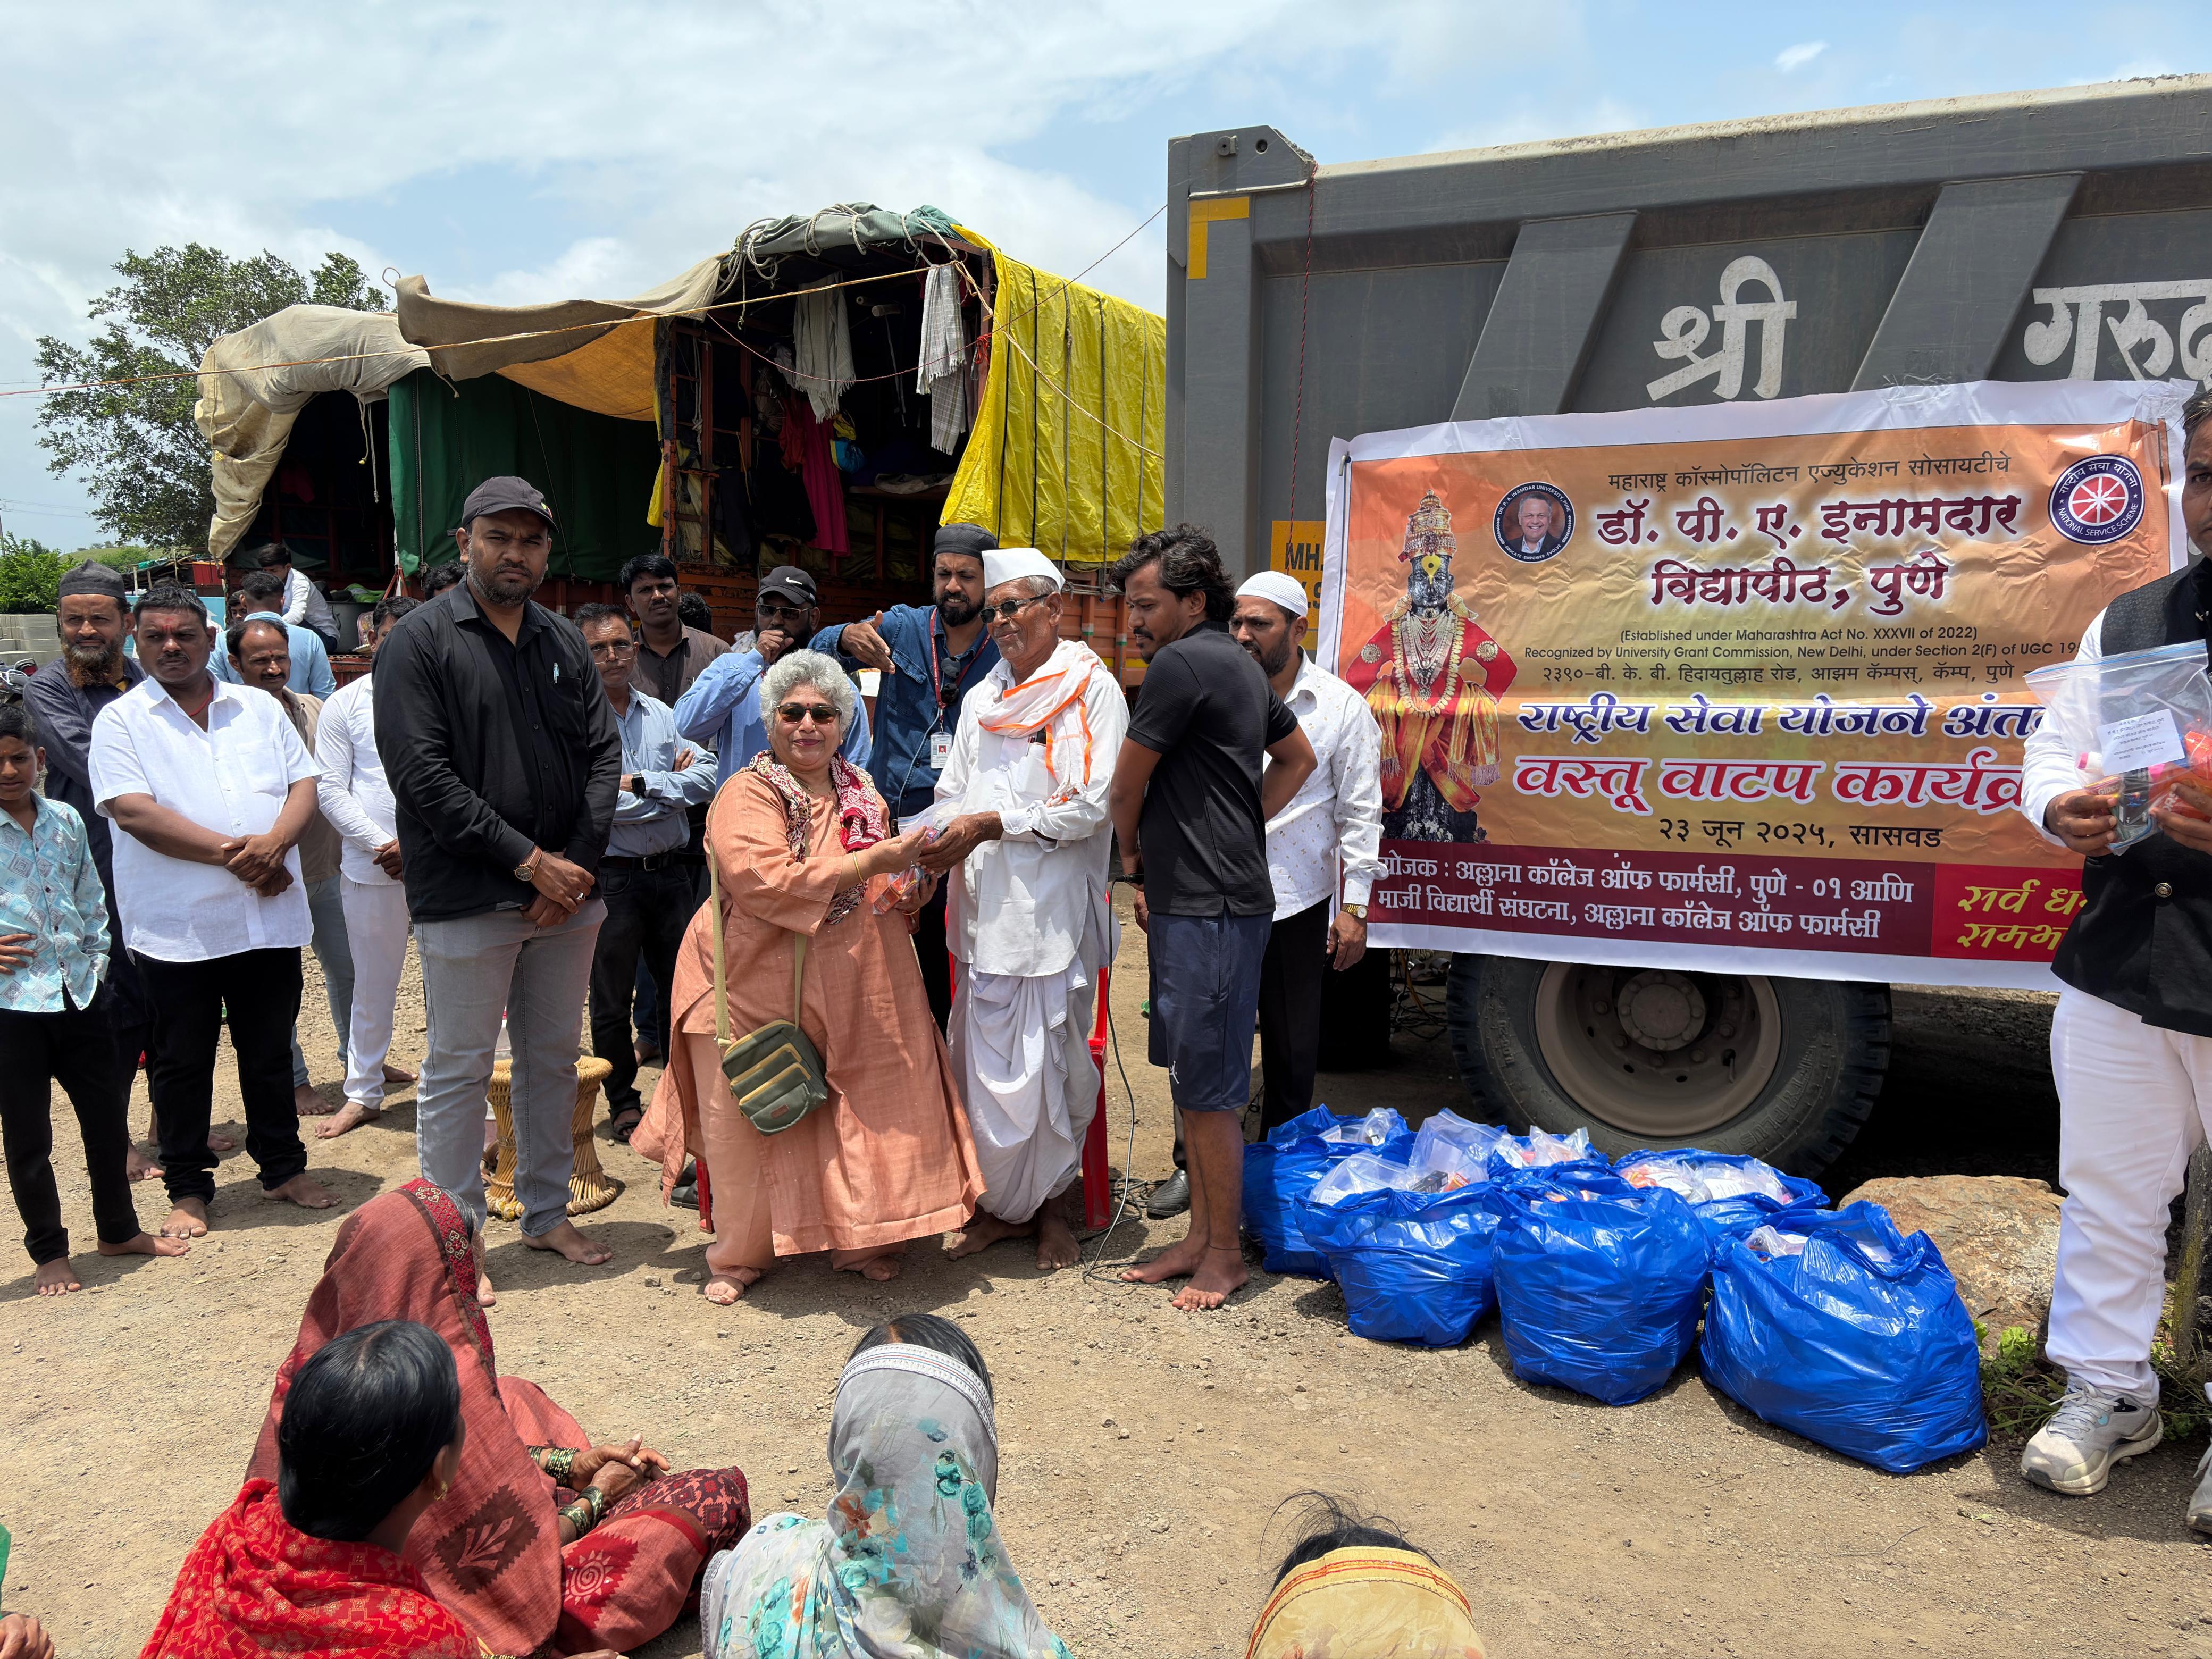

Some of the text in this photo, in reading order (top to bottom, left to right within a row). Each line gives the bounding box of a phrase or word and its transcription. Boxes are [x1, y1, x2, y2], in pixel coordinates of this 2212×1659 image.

[1646, 255, 1797, 401] श्री
[1608, 450, 2012, 492] महाराष्ट्र कॉस्मोपॉलिटन एज्युकेशन सोसायटीचे
[2059, 461, 2138, 493] राष्ट्रीय सेवा योजना
[1512, 485, 1536, 497] INAMDAR
[1536, 485, 1563, 501] UNIVERSITY,
[1562, 500, 1571, 513] PUNE
[1597, 495, 2022, 550] डॉ. पी. ए. इनामदार
[2058, 503, 2139, 537] NATIONAL SERVICE SCHEME
[1650, 551, 1949, 616] विद्यापीठ, पुणे
[1524, 647, 1594, 661] Recognized
[1597, 647, 1613, 661] by
[1615, 646, 1671, 661] University
[1674, 646, 1710, 658] Grant
[1712, 645, 1794, 659] Commission,
[1797, 646, 1828, 658] New
[1829, 644, 1867, 659] Delhi,
[1871, 646, 1912, 658] under
[1914, 643, 1968, 657] Section
[1971, 643, 1998, 659] 2(F)
[2001, 643, 2017, 656] of
[2021, 642, 2054, 655] UGC
[1620, 626, 1978, 643] (Established under Maharashtra Act No. XXXVII of 2022)
[1622, 662, 1643, 681] के.
[1649, 663, 1671, 681] बी.
[1770, 663, 1803, 683] रोड,
[1811, 666, 1860, 681] आझम
[1932, 661, 1976, 683] कॅम्प,
[1985, 660, 2015, 684] पुणे
[1519, 693, 2046, 743] राष्ट्रीय सेवा योजने अंत
[1516, 759, 1649, 812] वस्तू
[1662, 762, 1822, 800] वाटप
[1659, 818, 1943, 849] २३ जून २०२५, सासवड
[1455, 860, 1522, 887] अल्लाना
[1528, 858, 1595, 887] कॉलेज
[1601, 861, 1653, 890] ऑफ
[1658, 864, 1742, 899] फार्मसी,
[1749, 868, 1788, 904] पुणे
[1812, 876, 1842, 900] ०१
[1850, 872, 1915, 903] आणि
[1958, 879, 2088, 915] सर्व ध
[1378, 884, 1882, 940] माजी विद्यार्थी संघटना, अल्लाना कॉलेज ऑफ फार्मसी
